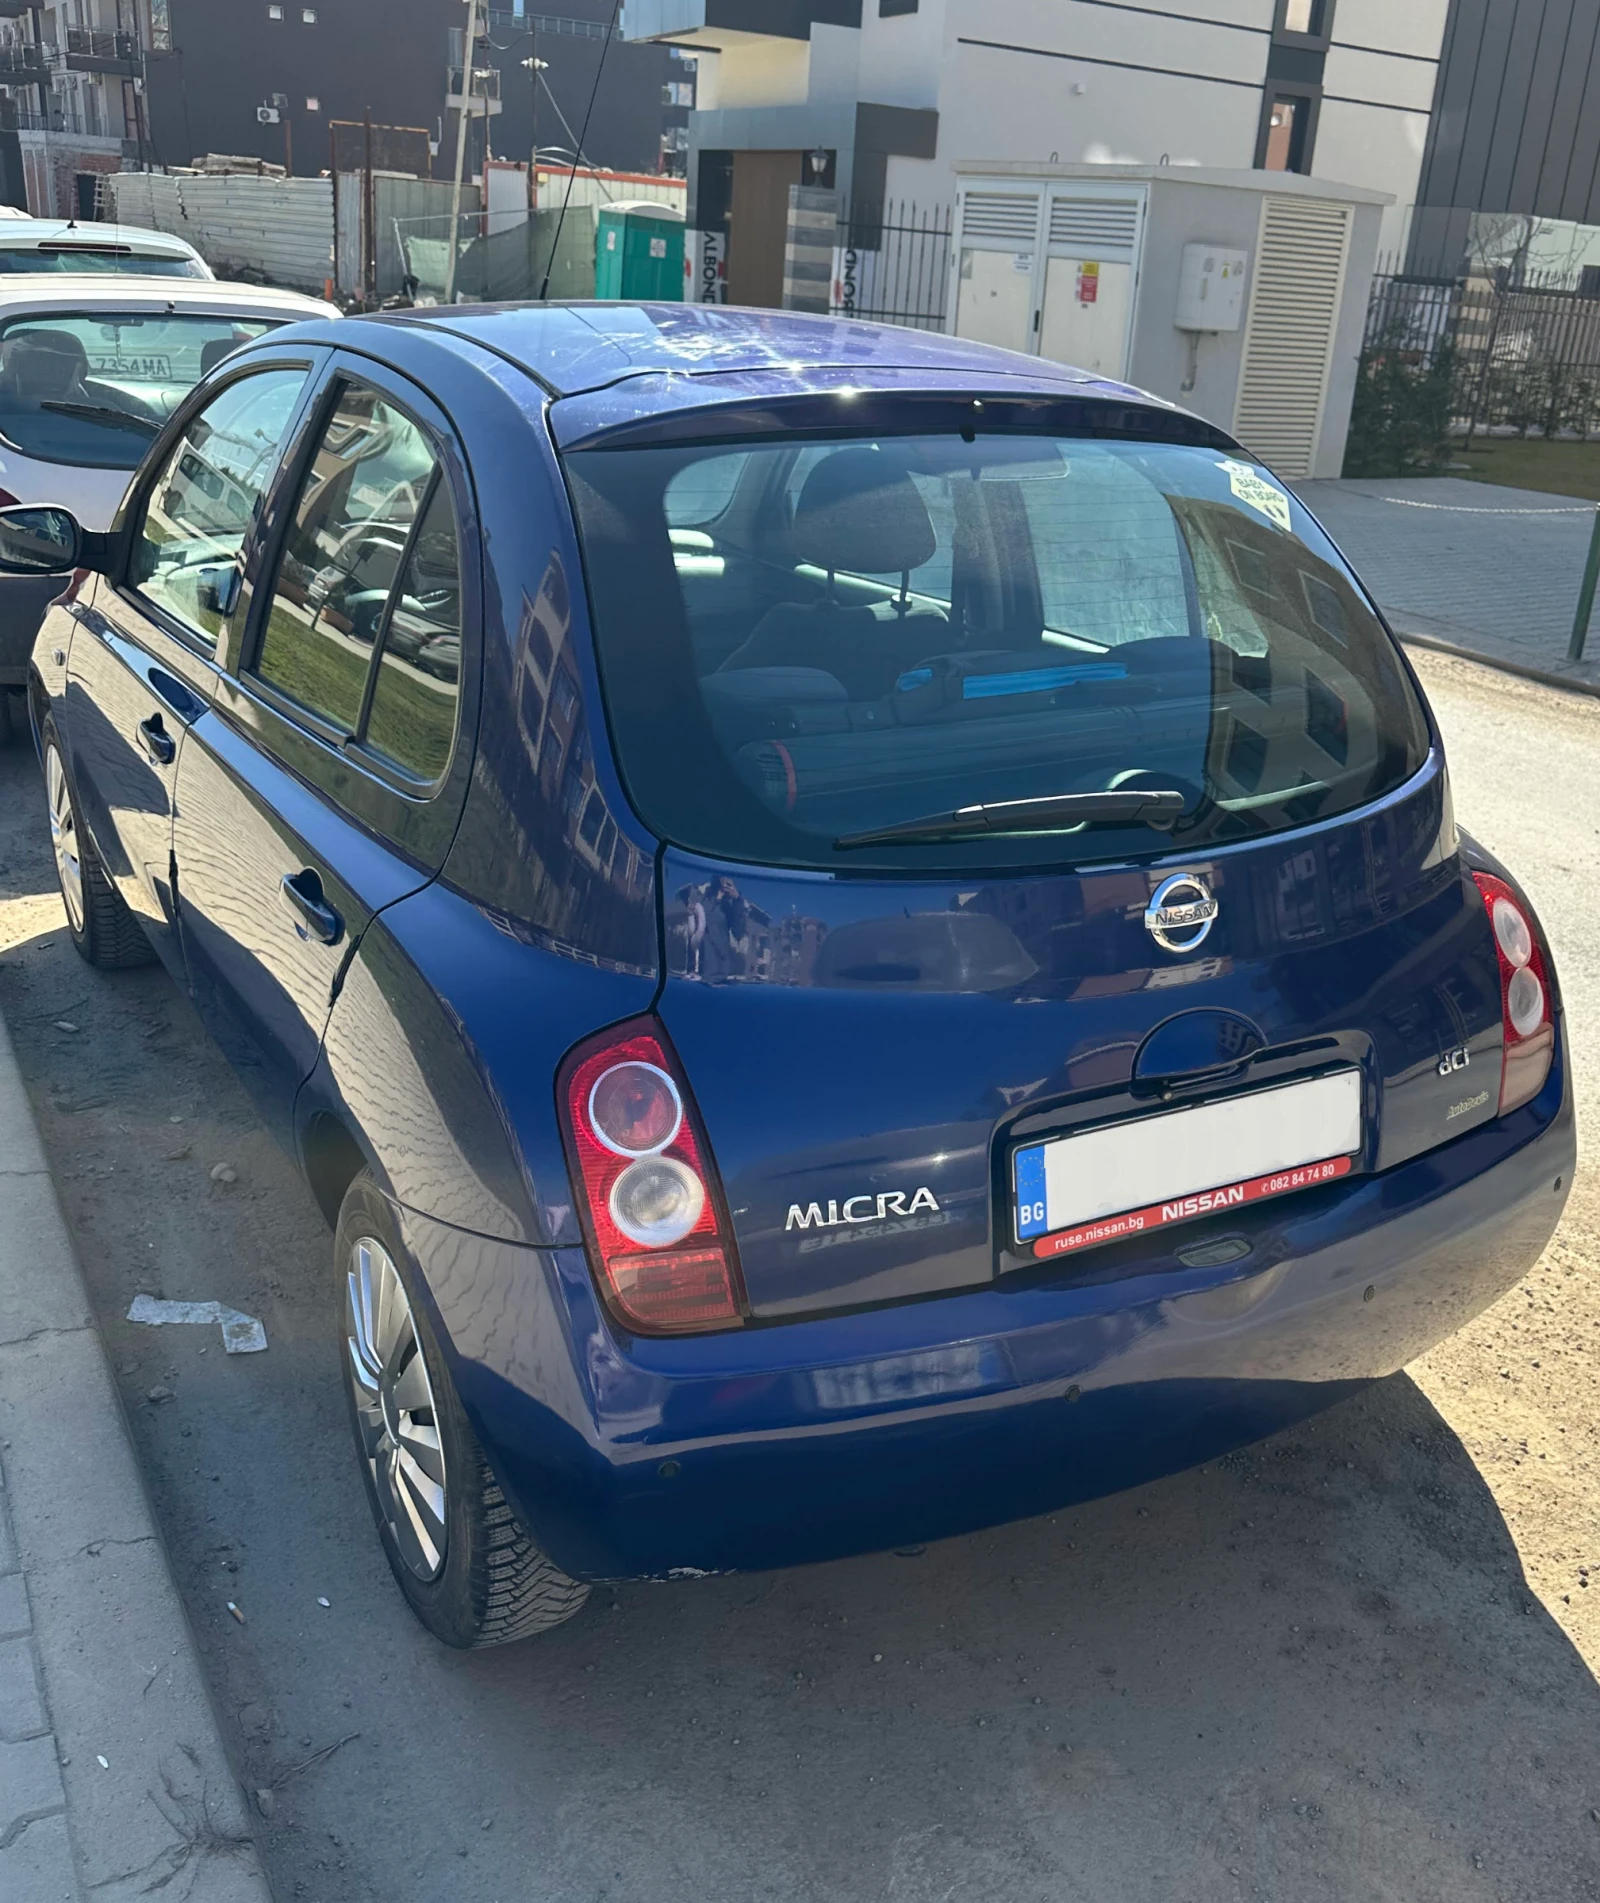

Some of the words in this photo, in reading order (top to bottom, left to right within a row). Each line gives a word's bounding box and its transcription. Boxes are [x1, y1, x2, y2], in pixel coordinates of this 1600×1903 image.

[844, 249, 857, 318] BOND
[1235, 477, 1265, 490] BABY
[1238, 489, 1256, 500] ON
[1155, 904, 1214, 924] NISSAN
[1438, 1047, 1470, 1076] dCi
[785, 1186, 940, 1231] MICRA
[1020, 1201, 1044, 1226] BG
[1055, 1216, 1145, 1250] ruse.nissan.bg
[1162, 1185, 1244, 1222] NISSAN
[1270, 1176, 1289, 1191] 082
[1292, 1172, 1304, 1185] 84
[1307, 1168, 1320, 1181] 74
[1322, 1164, 1335, 1177] 80
